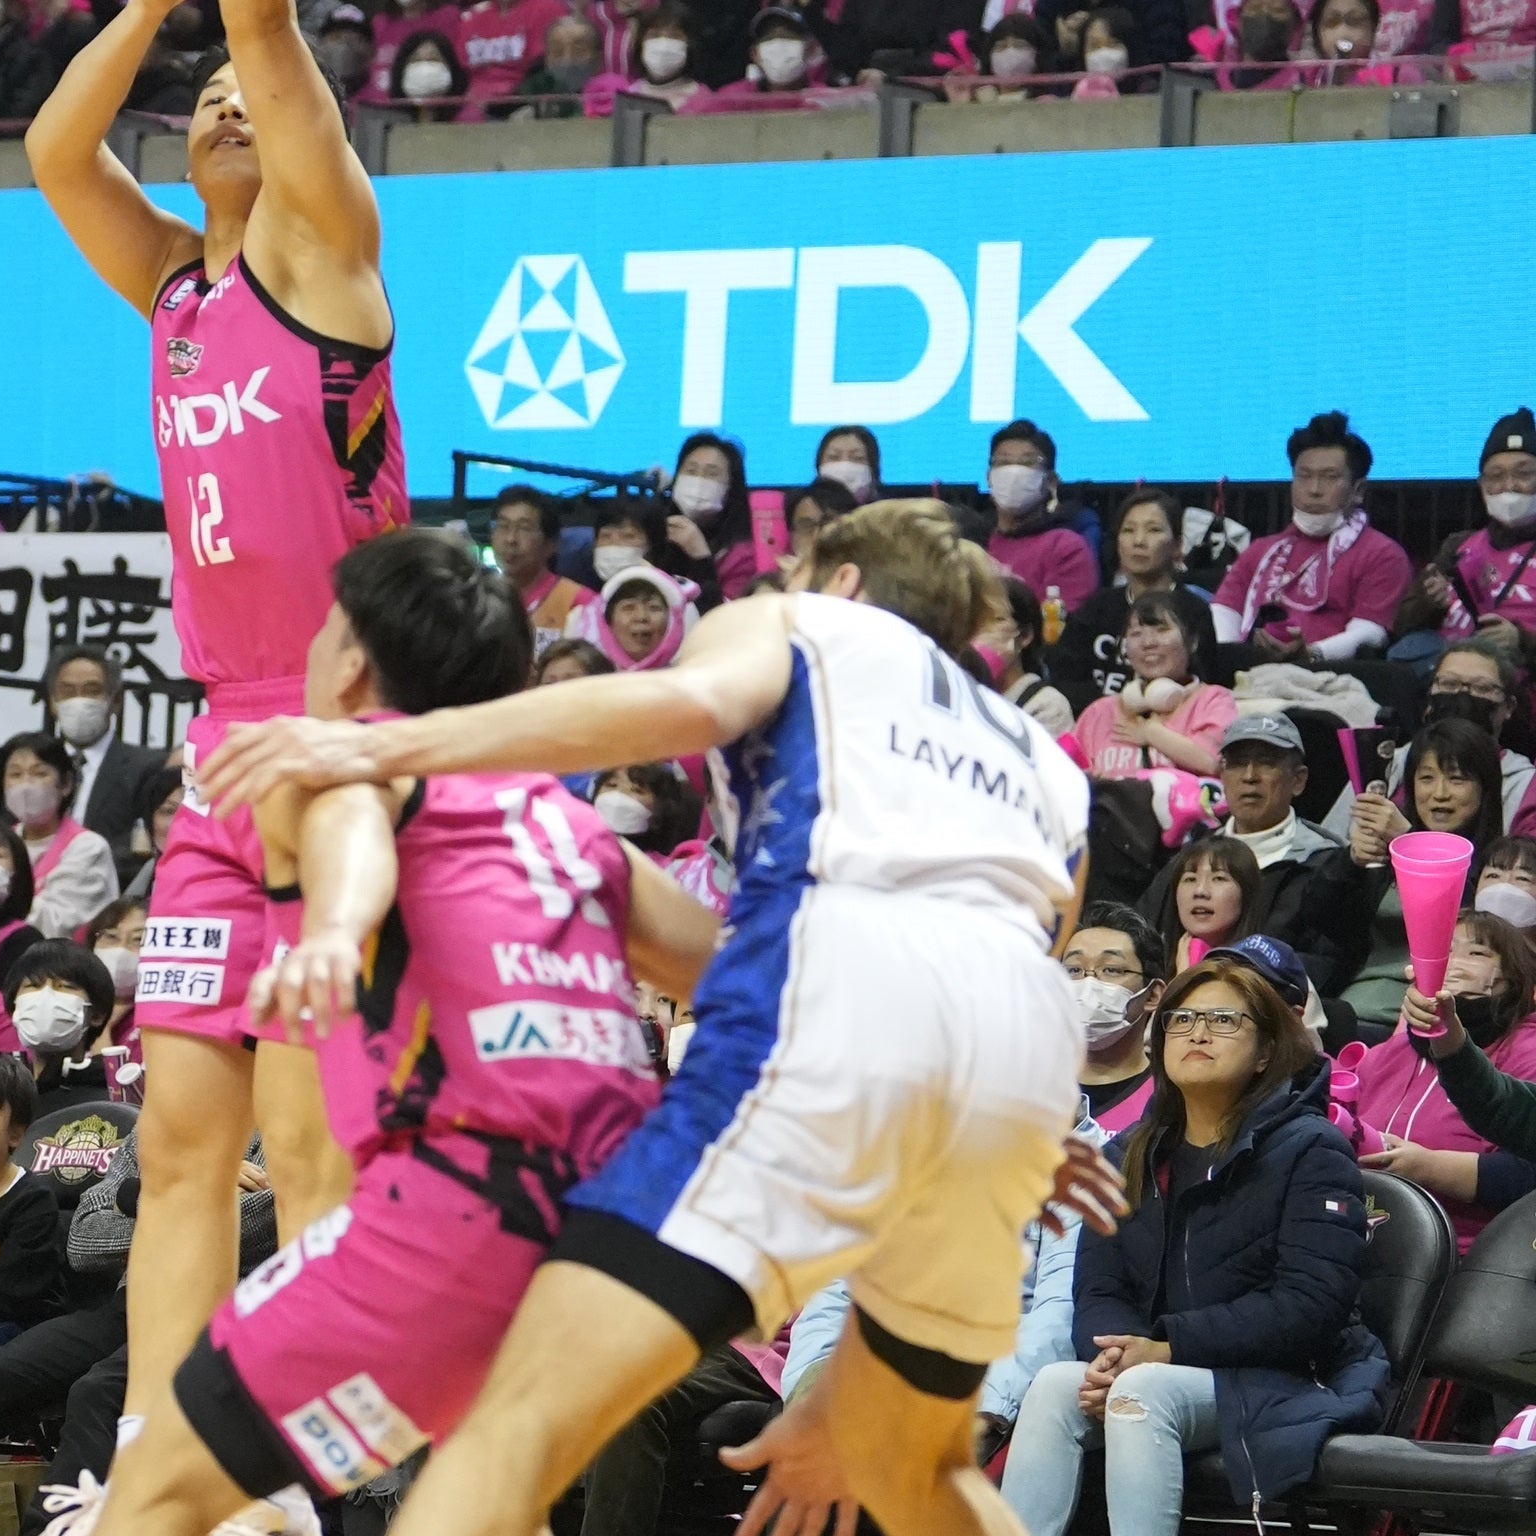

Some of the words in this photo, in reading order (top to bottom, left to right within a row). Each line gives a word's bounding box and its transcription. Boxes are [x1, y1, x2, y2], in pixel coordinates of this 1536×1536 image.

[622, 236, 1154, 428] TDK
[187, 472, 235, 567] 12
[137, 969, 215, 998] 田銀行
[32, 1142, 119, 1174] HAPPINETS
